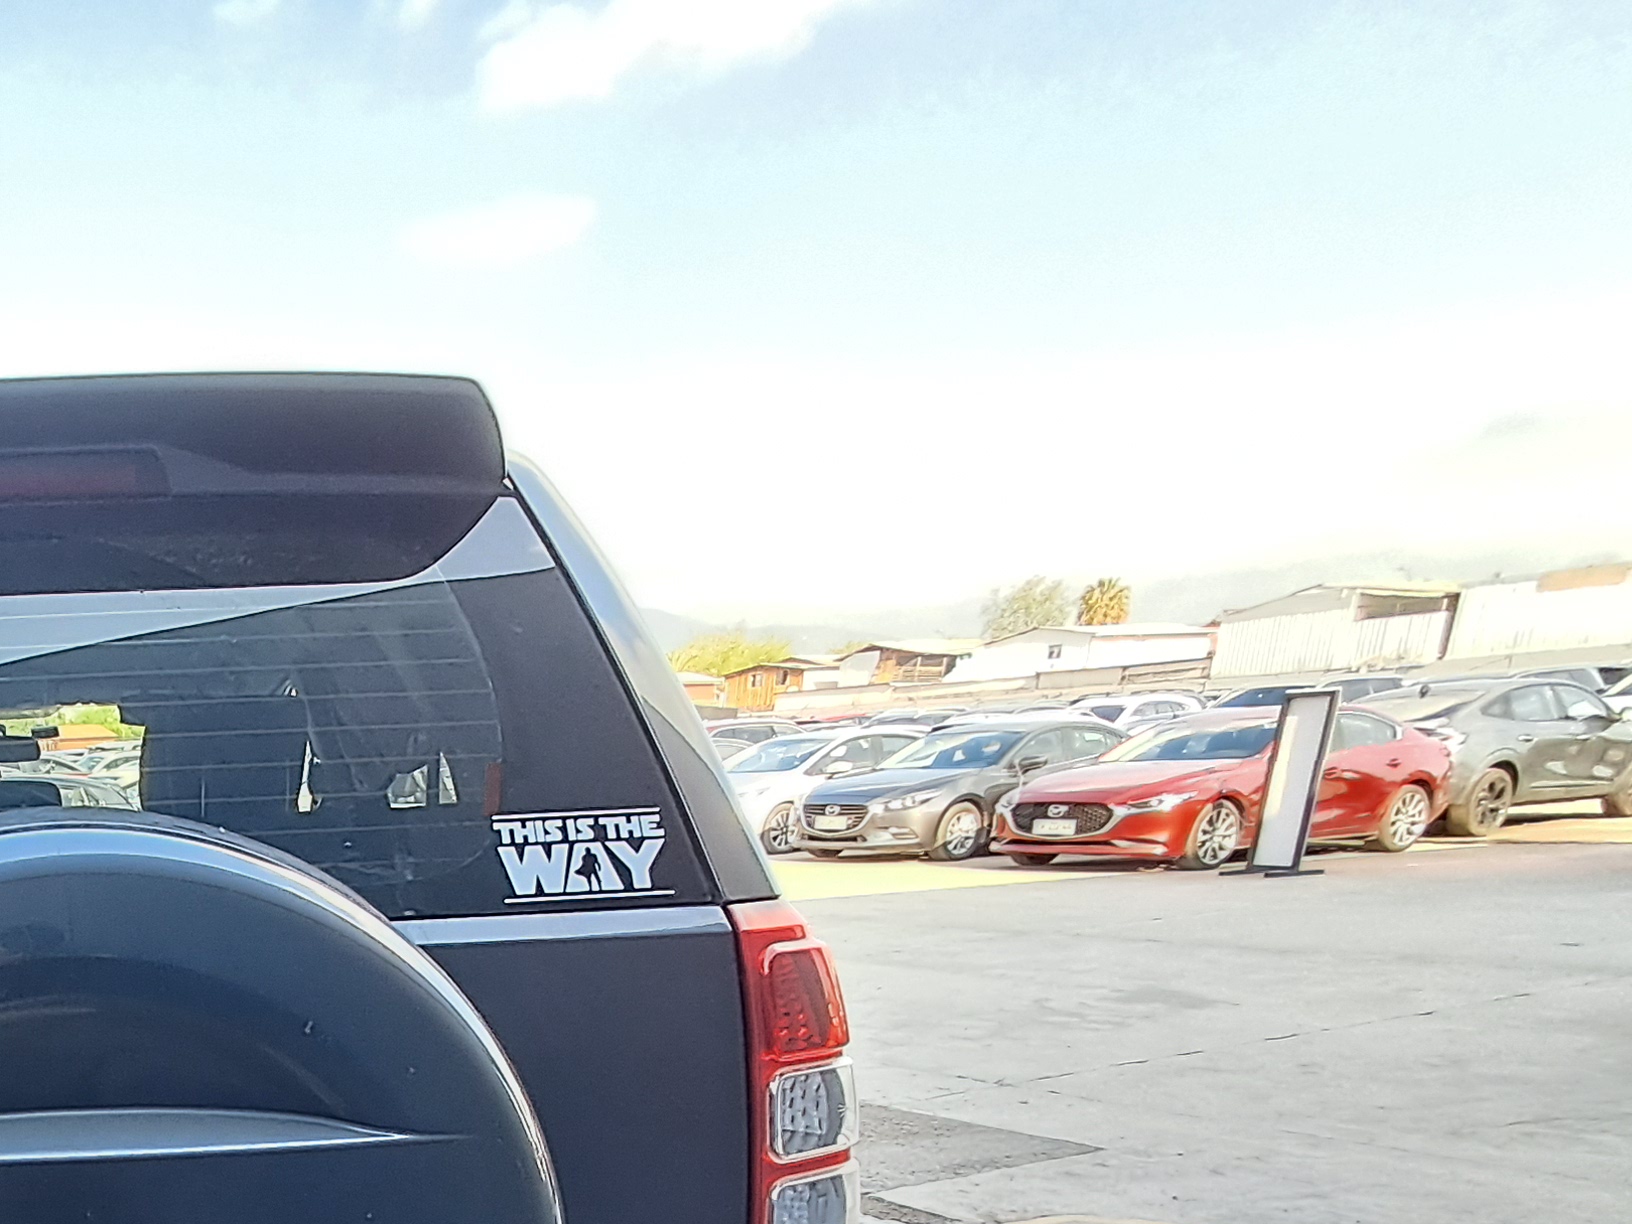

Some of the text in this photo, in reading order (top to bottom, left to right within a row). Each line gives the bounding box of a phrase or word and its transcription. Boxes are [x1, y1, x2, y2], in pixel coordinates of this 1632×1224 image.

[492, 813, 666, 845] THIS IS THE
[496, 837, 666, 896] WAY
